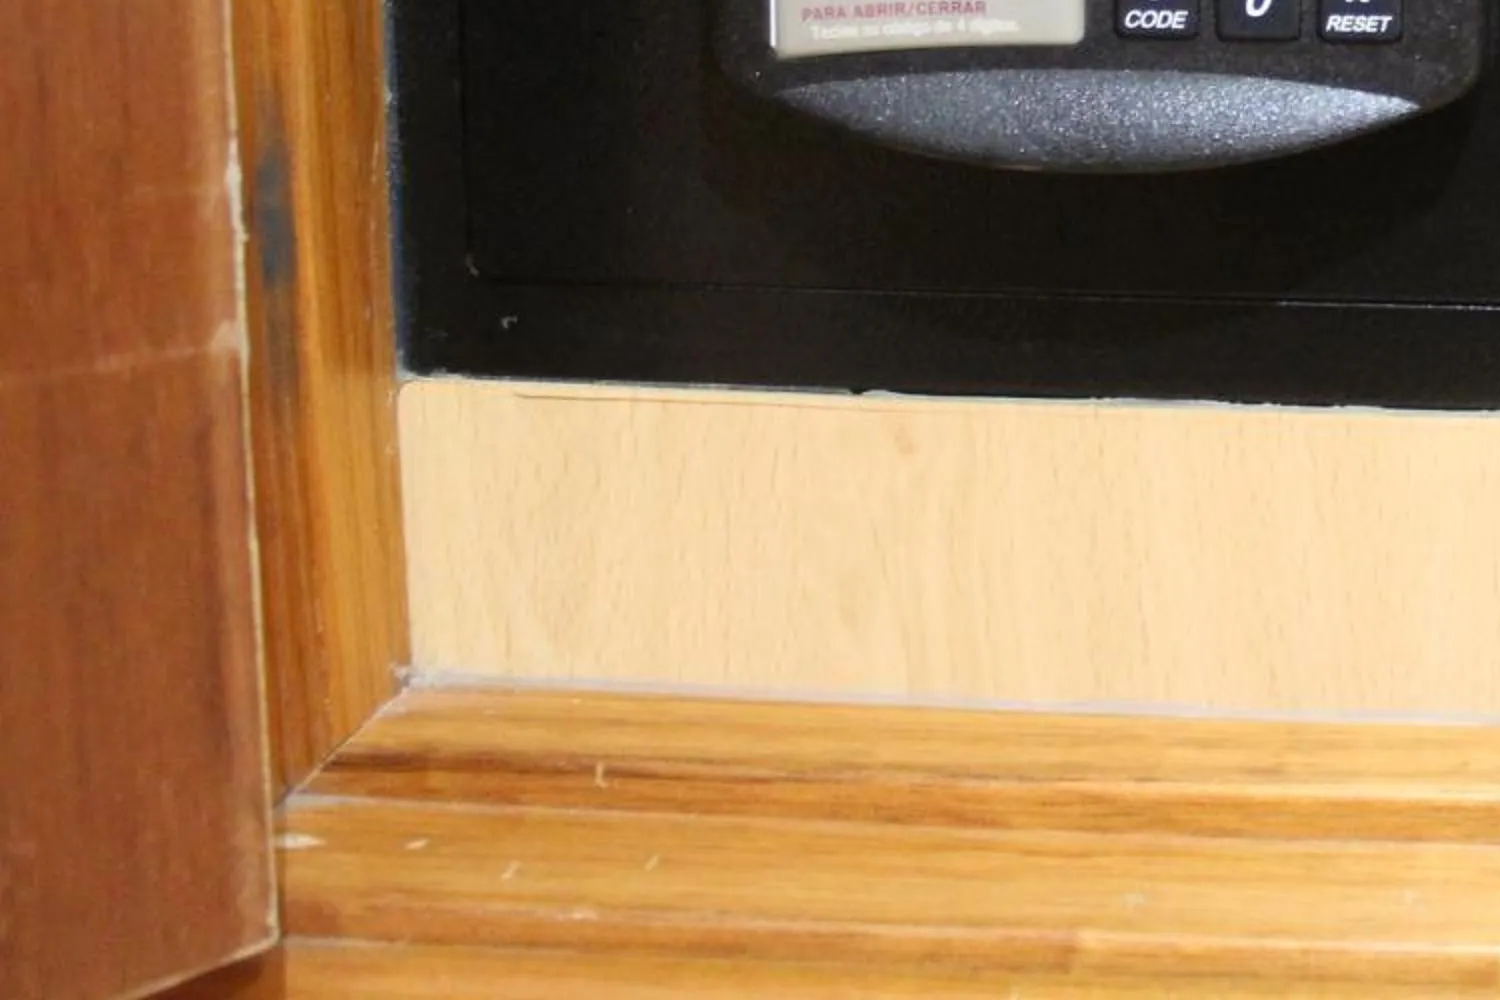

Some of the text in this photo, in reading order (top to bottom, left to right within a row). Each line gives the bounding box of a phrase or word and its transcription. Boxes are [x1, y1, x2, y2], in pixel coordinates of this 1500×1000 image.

[801, 0, 987, 22] PARA ABRIR/CERRAR
[1124, 8, 1189, 30] CODE
[1325, 13, 1393, 33] RESET
